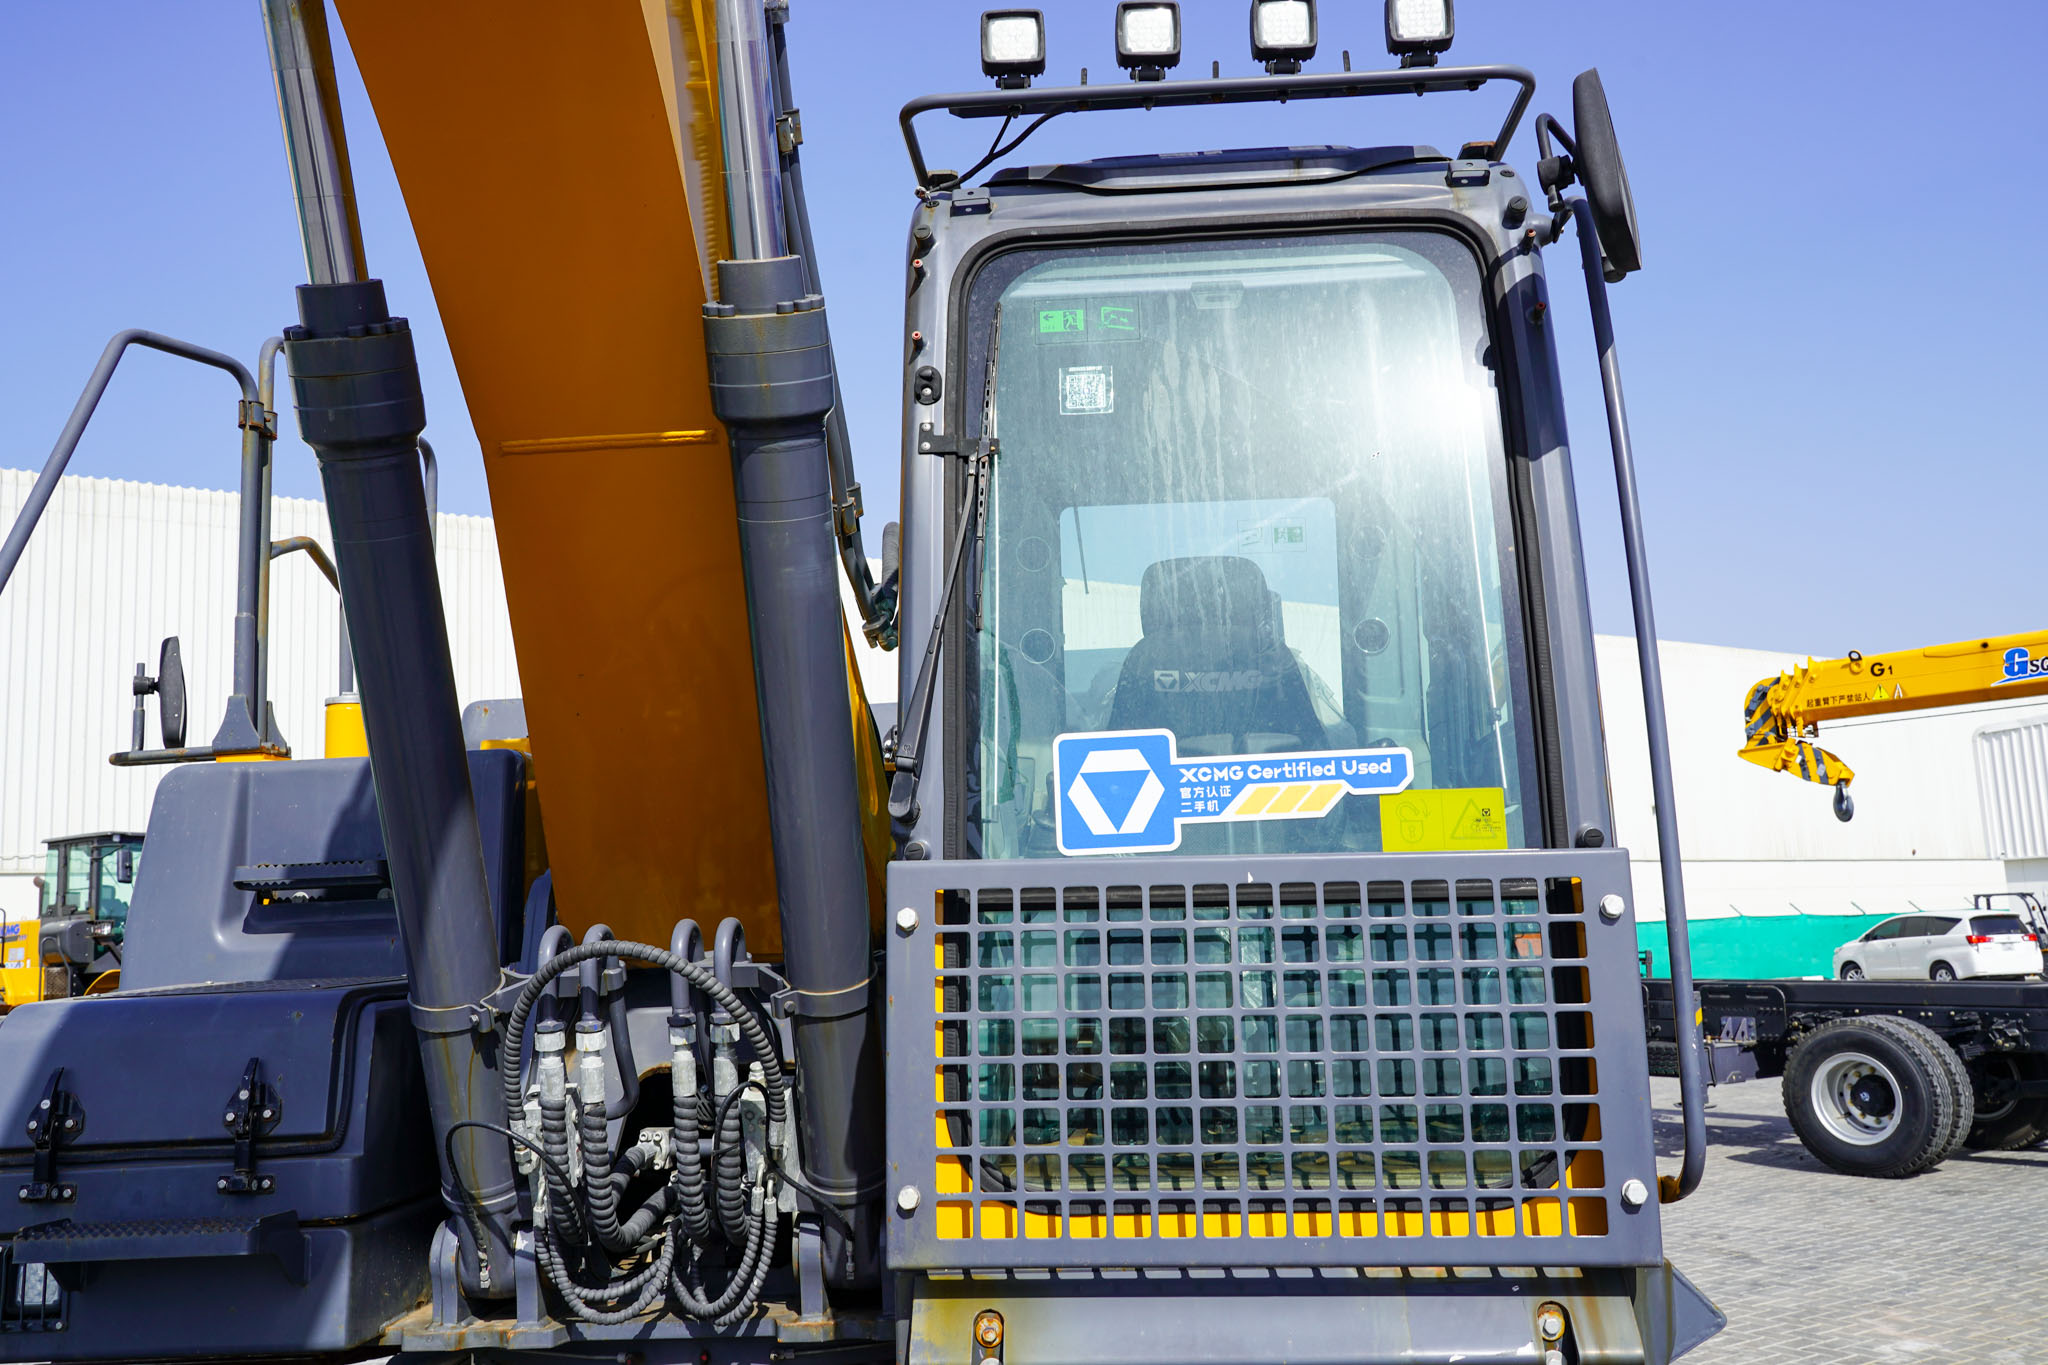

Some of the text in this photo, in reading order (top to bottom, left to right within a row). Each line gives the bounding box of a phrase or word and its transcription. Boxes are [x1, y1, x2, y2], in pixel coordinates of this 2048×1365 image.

[1183, 670, 1262, 692] XCMG
[1178, 757, 1392, 783] XCMG Certified Used
[1179, 785, 1232, 799] 官方认证
[1180, 799, 1220, 812] 二手机
